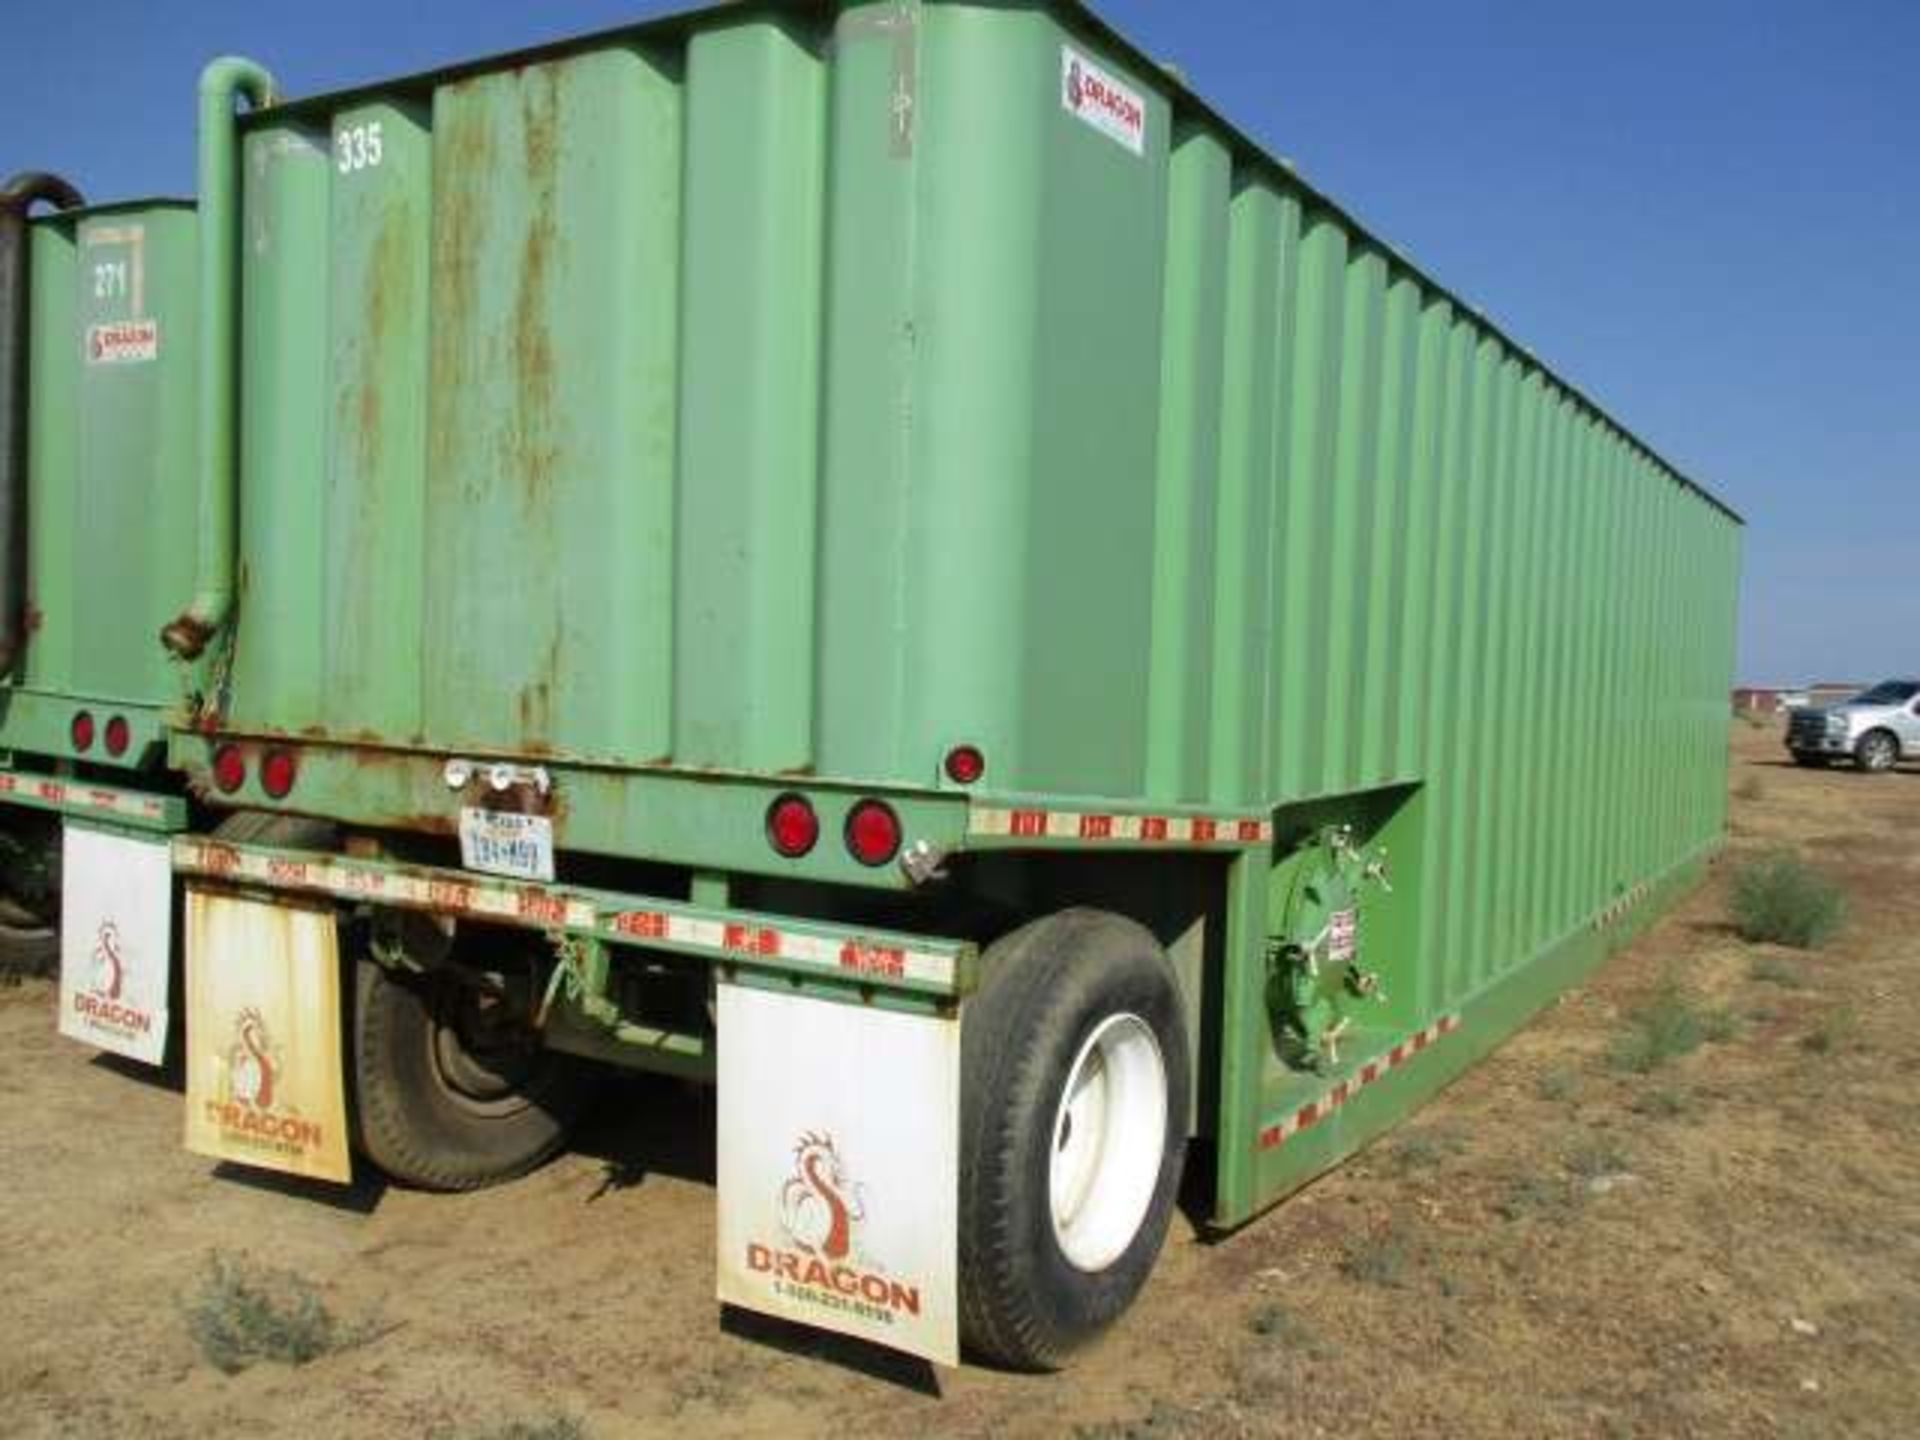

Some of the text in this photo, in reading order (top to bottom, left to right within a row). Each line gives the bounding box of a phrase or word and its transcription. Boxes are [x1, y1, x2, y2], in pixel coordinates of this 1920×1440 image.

[1085, 74, 1141, 132] DRAGON
[338, 122, 382, 173] 335
[95, 262, 126, 297] 271
[74, 992, 151, 1033] DRAGON
[747, 1243, 920, 1316] DRAGON
